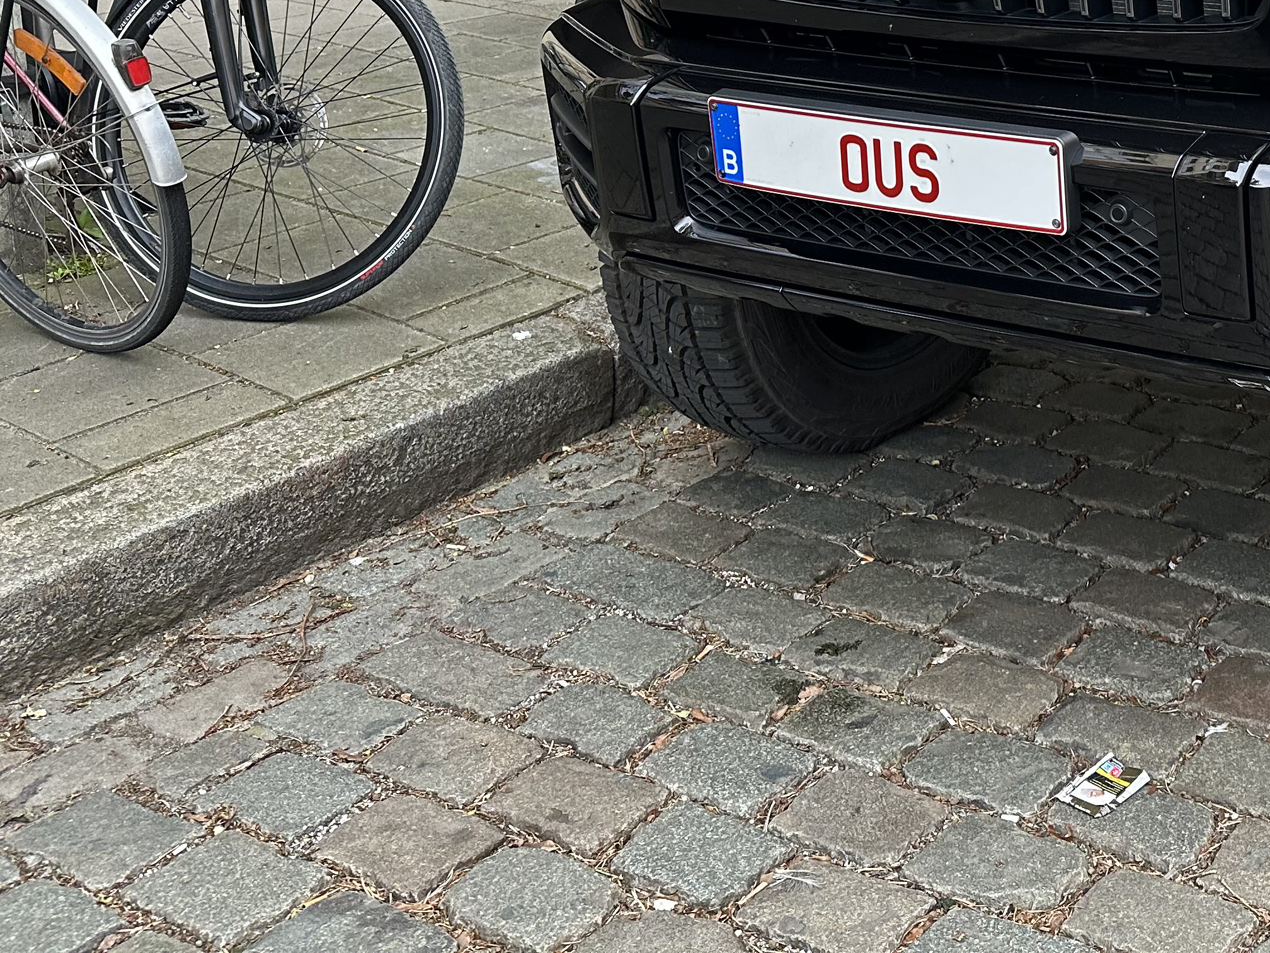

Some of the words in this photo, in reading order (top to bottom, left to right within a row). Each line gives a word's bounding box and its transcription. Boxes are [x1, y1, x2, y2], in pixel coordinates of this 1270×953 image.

[722, 148, 739, 175] B
[839, 133, 940, 203] OUS
[384, 228, 412, 261] PROTECTION
